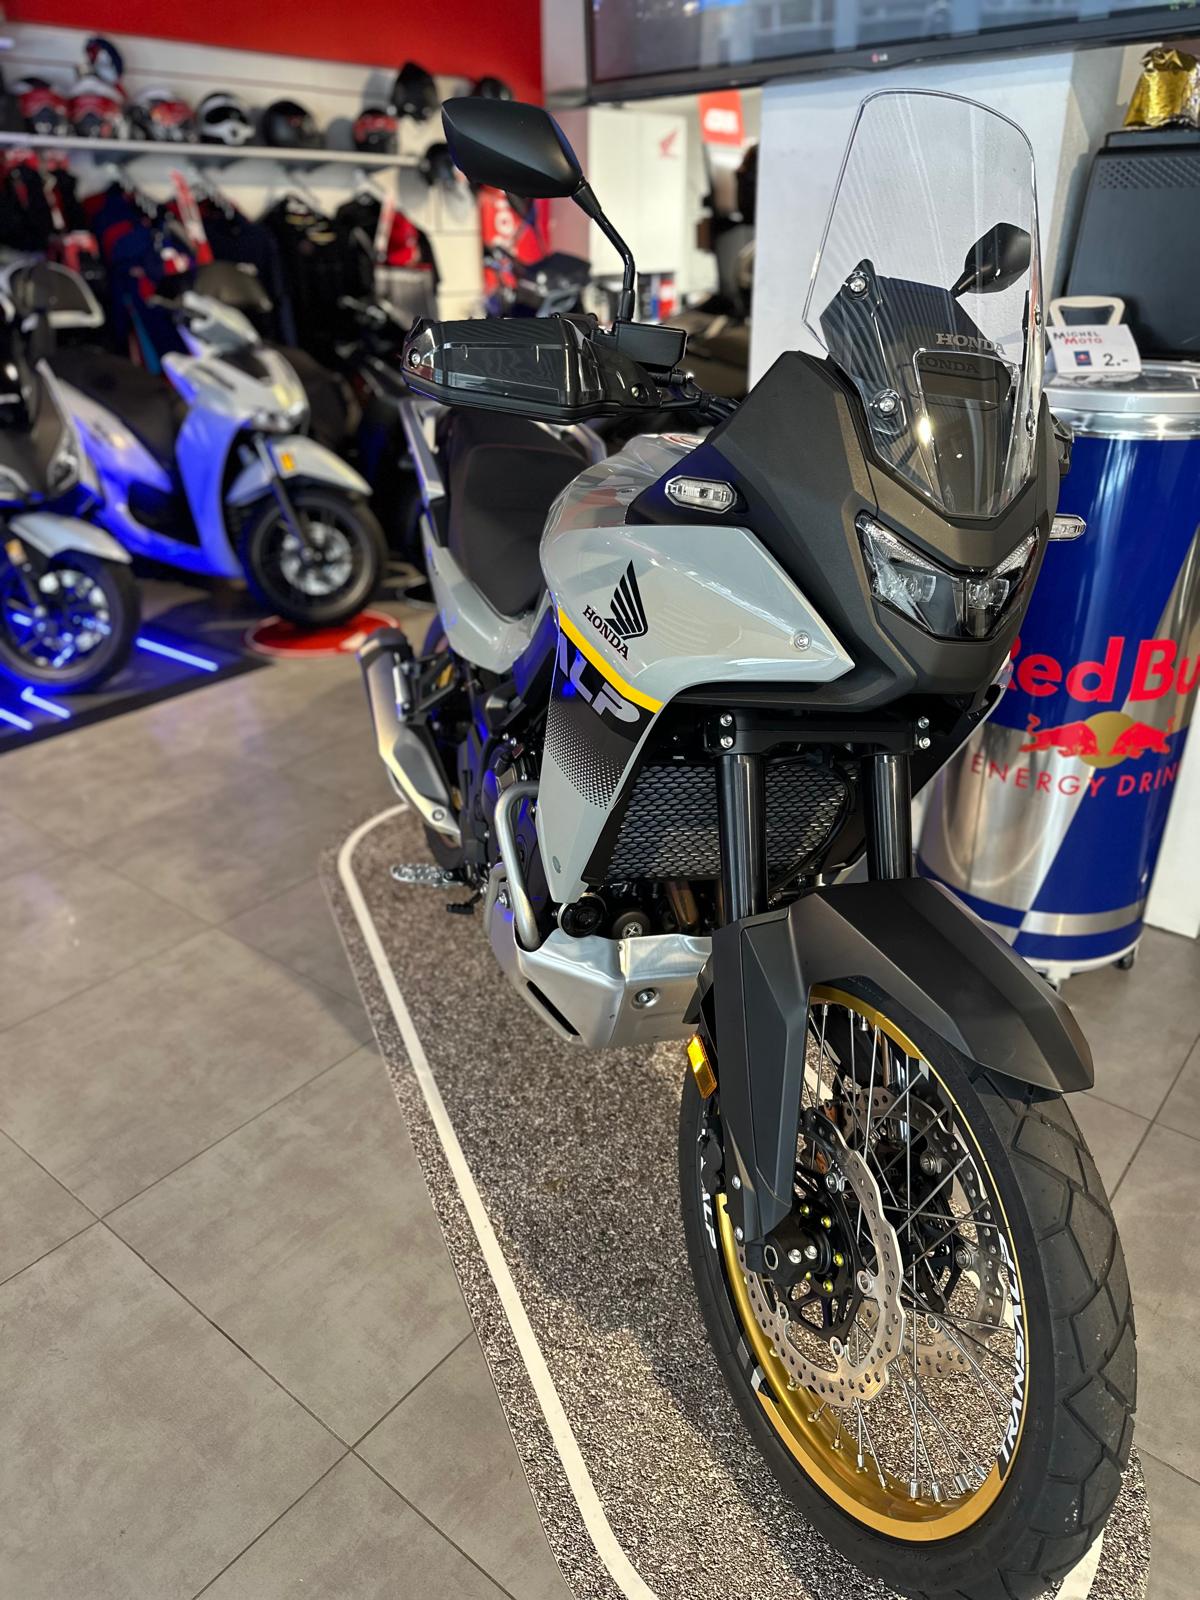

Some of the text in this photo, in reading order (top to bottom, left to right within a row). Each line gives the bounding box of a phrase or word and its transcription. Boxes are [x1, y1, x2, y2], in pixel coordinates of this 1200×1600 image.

[936, 333, 1006, 355] HONDA
[1103, 353, 1129, 367] 2.-
[582, 604, 630, 660] HONDA
[970, 753, 1107, 798] ENERGY
[998, 1231, 1025, 1464] TRANSALP
